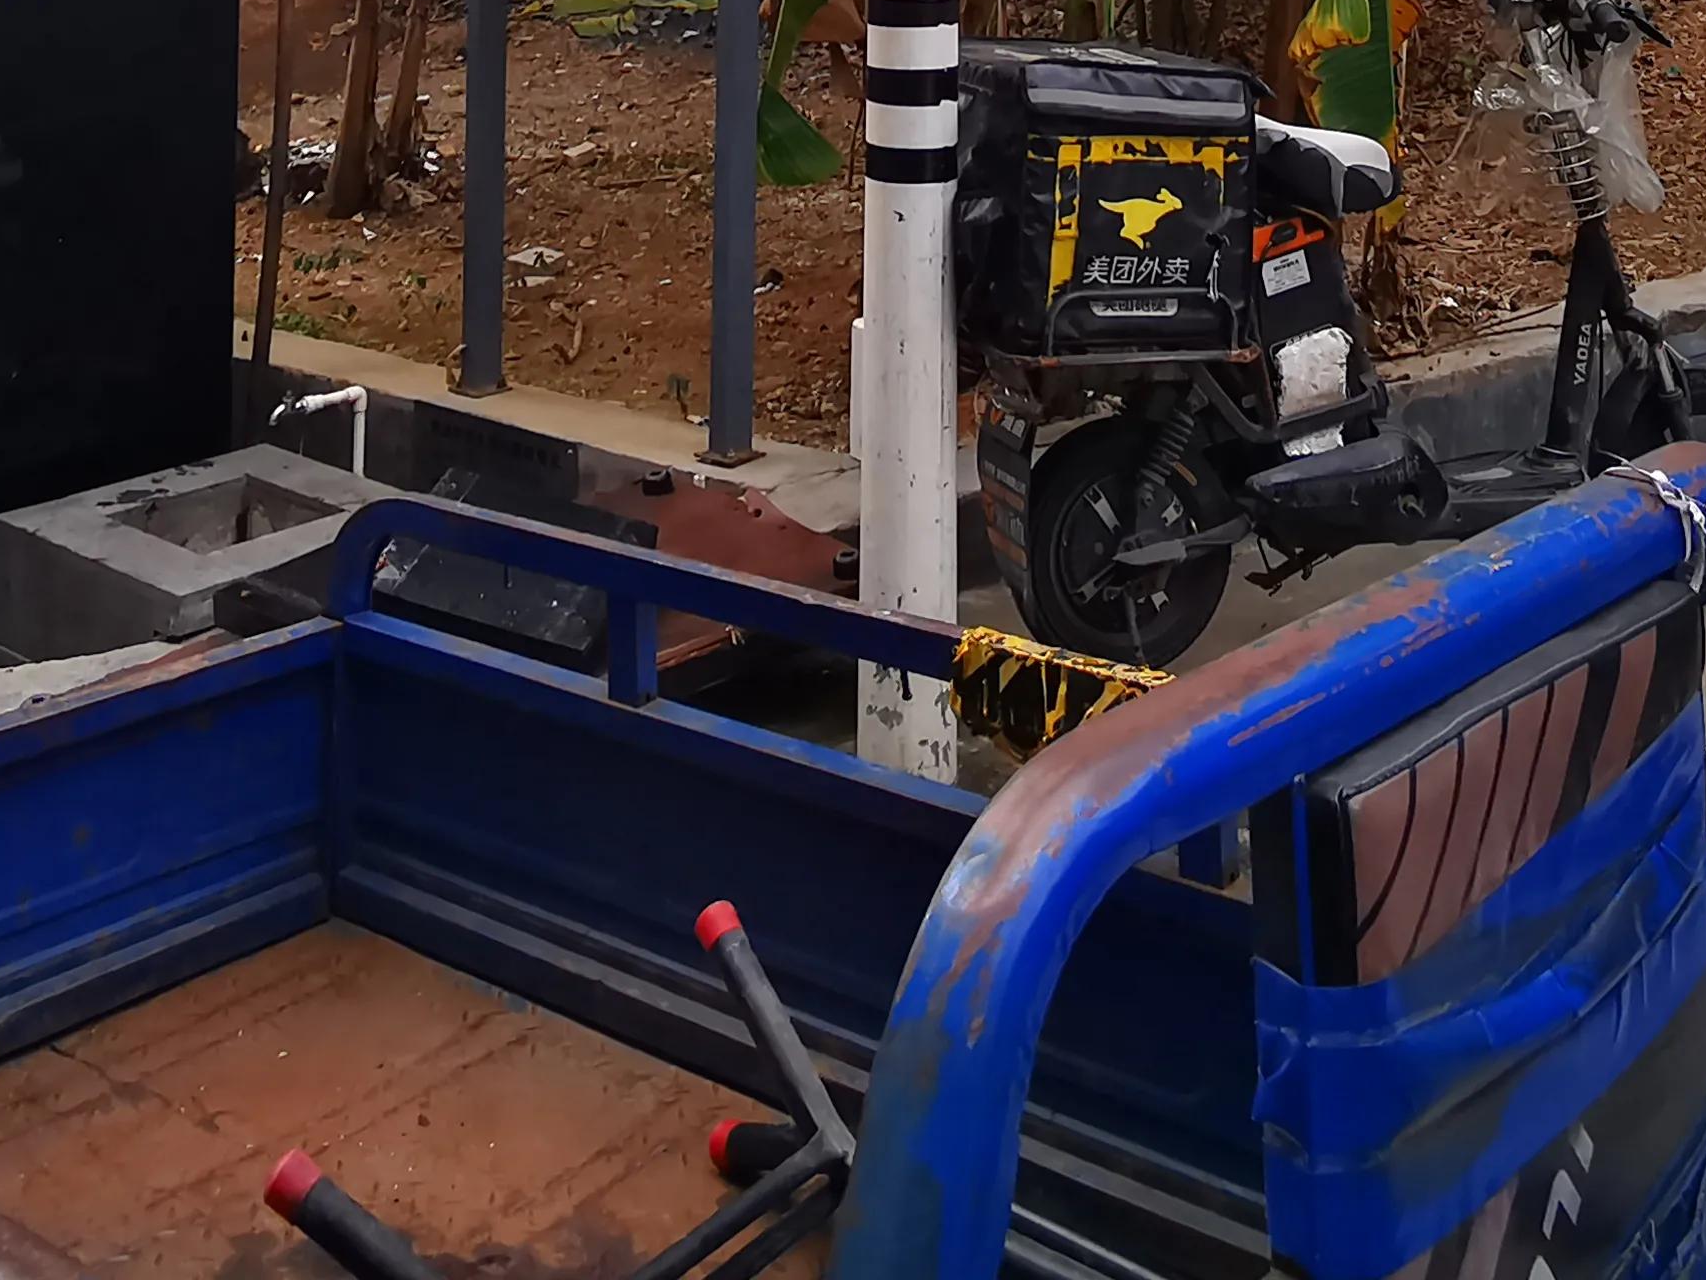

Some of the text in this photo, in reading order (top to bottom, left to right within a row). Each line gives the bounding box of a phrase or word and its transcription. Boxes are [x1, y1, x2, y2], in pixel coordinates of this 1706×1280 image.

[1082, 255, 1190, 285] 美团外卖
[1573, 323, 1593, 385] YADEA
